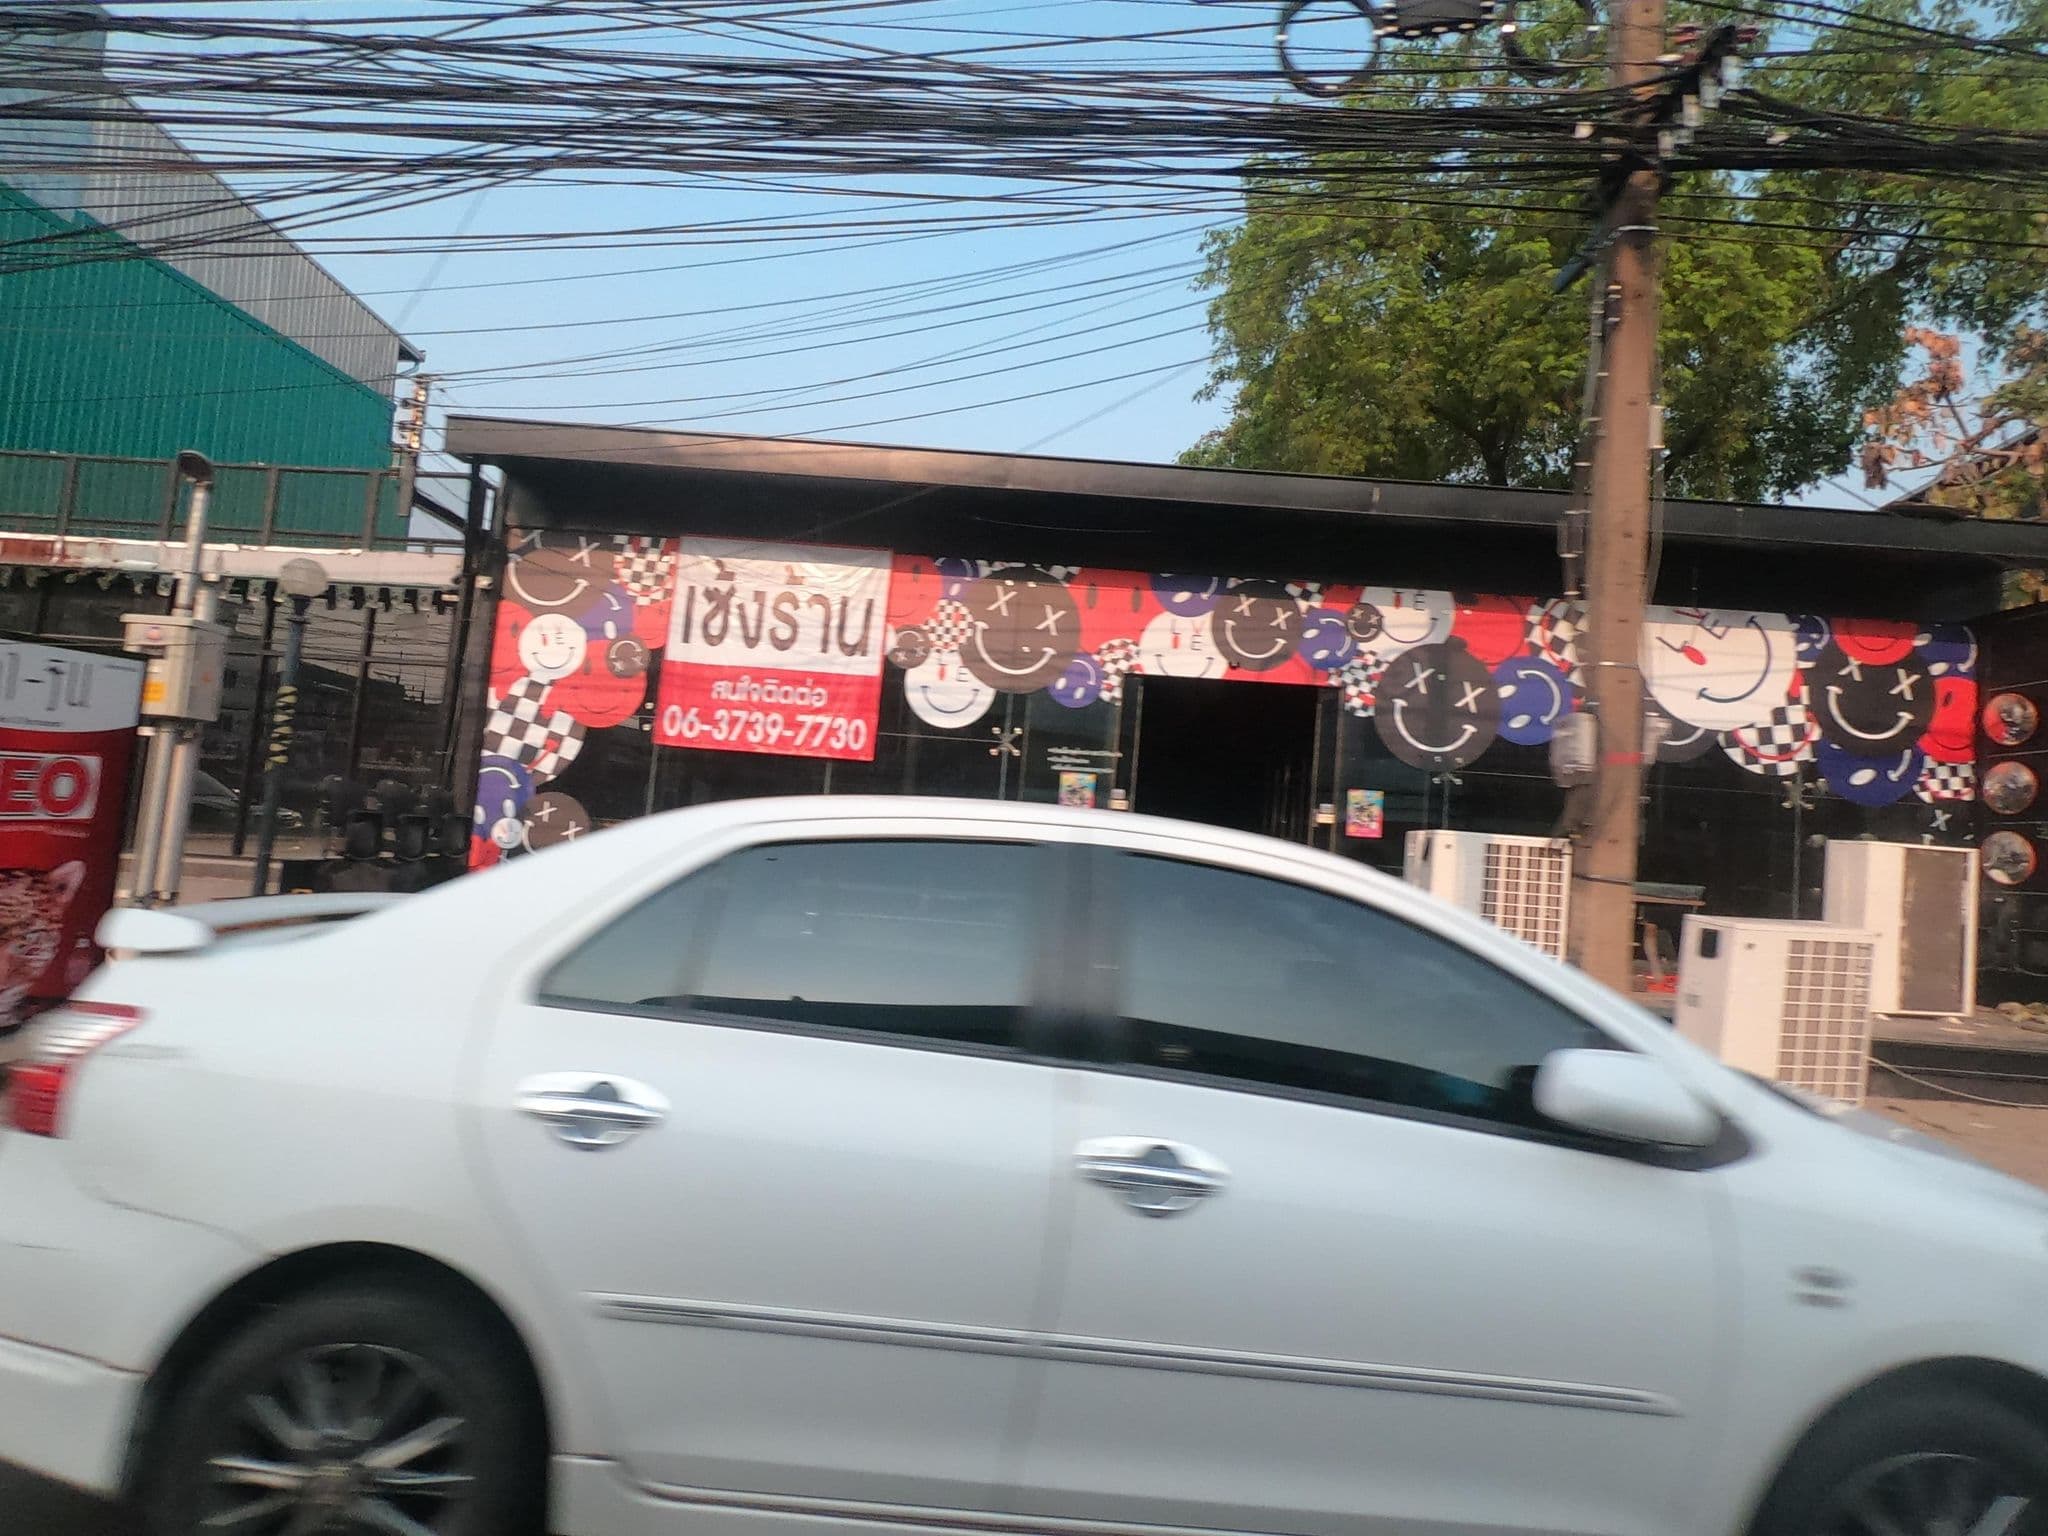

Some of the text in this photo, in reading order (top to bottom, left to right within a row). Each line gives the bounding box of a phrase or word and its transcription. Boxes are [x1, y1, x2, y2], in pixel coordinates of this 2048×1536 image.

[682, 558, 874, 657] เซ้งร้าน
[711, 675, 828, 708] สนใจติดต่อ
[662, 704, 867, 751] 06-3739-7730
